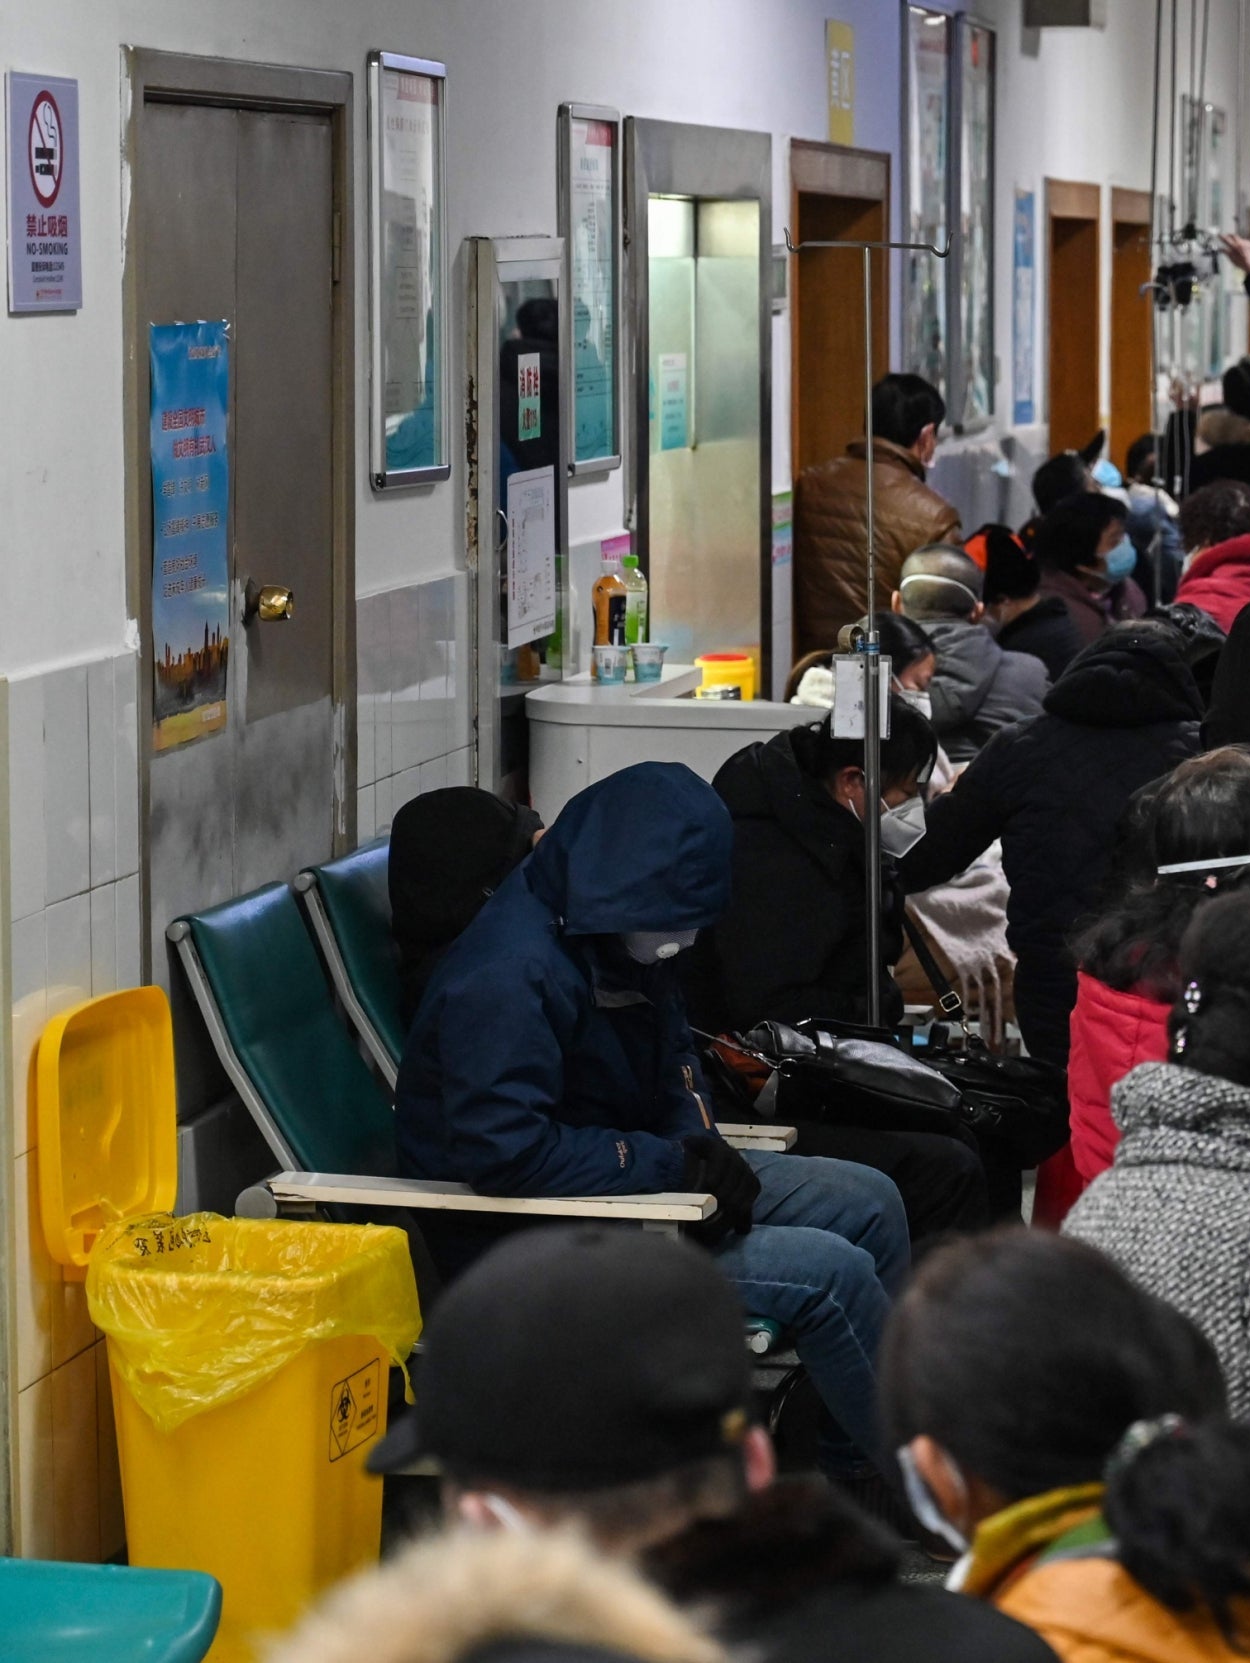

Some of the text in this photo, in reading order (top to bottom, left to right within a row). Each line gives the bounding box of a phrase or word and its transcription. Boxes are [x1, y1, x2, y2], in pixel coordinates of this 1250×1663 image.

[26, 214, 68, 237] 禁止吸烟
[26, 242, 68, 255] NO-SMOKING
